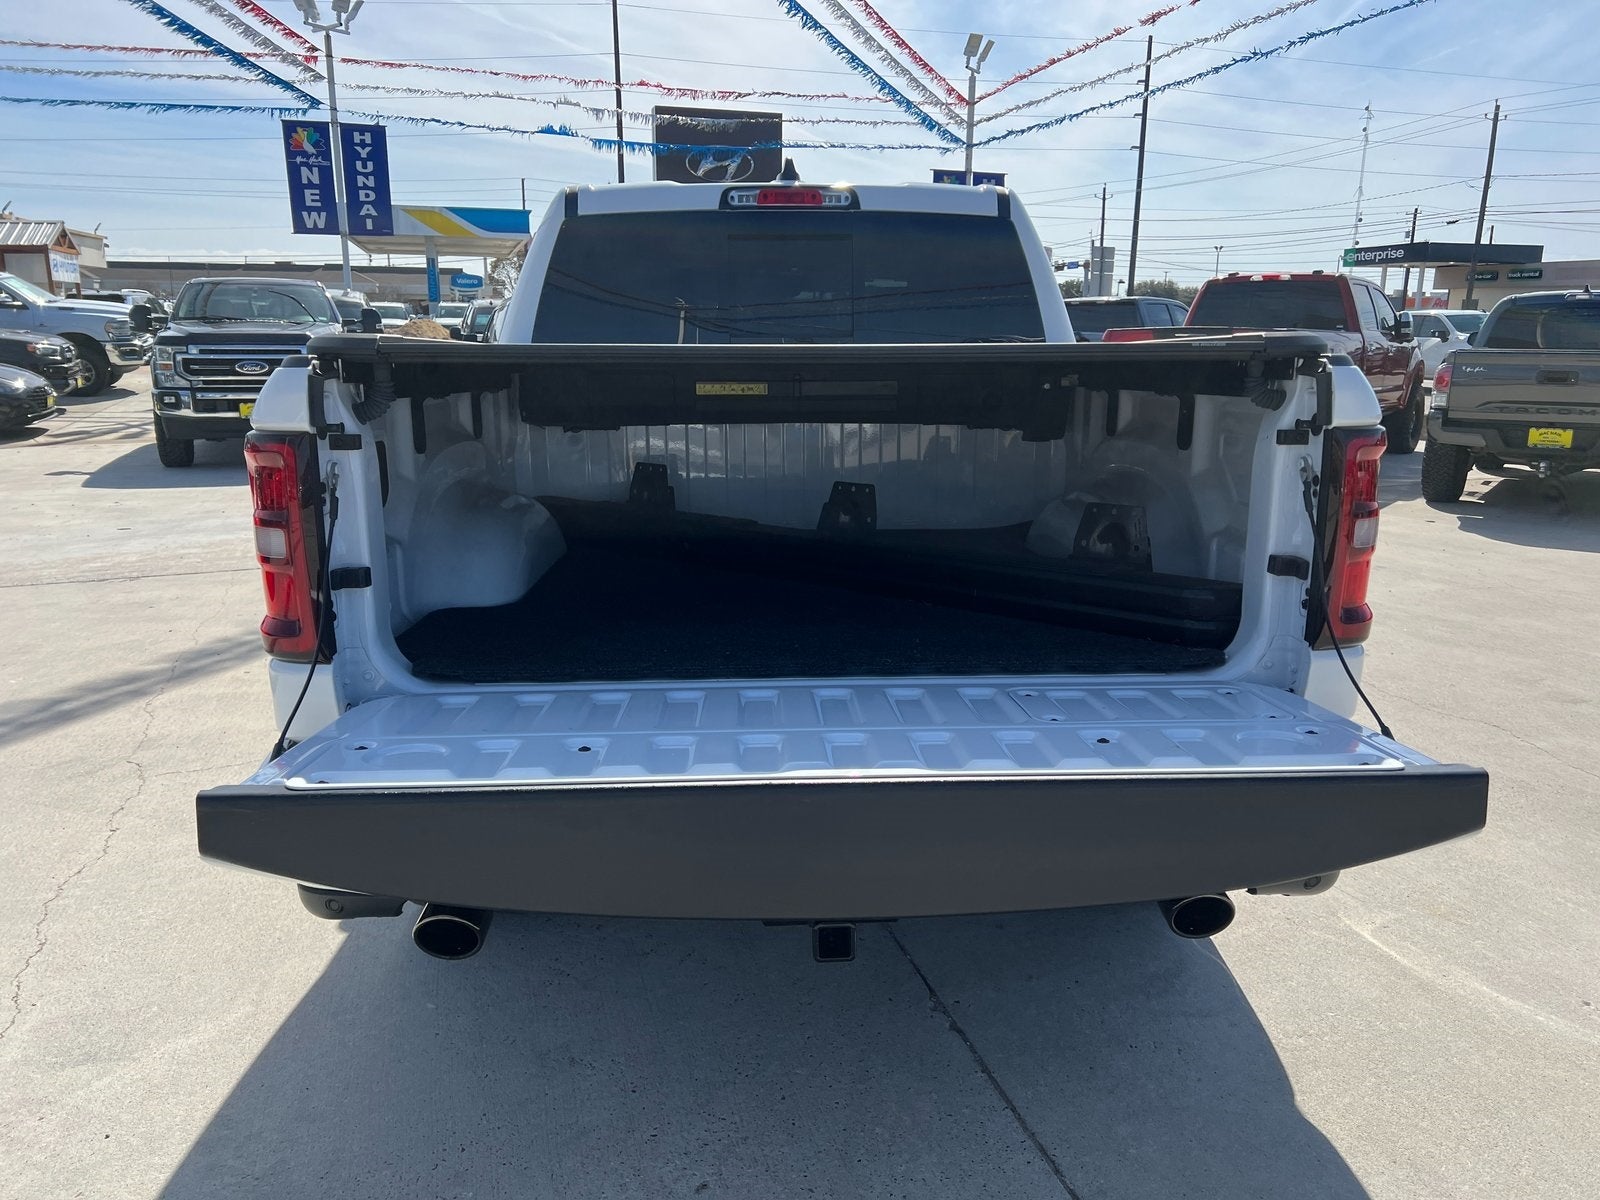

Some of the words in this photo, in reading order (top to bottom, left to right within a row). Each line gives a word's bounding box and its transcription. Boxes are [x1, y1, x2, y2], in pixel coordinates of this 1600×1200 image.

[300, 166, 327, 229] NEW
[353, 131, 378, 230] HYUNDAI
[1345, 248, 1405, 262] enterprise
[243, 362, 261, 371] Ford
